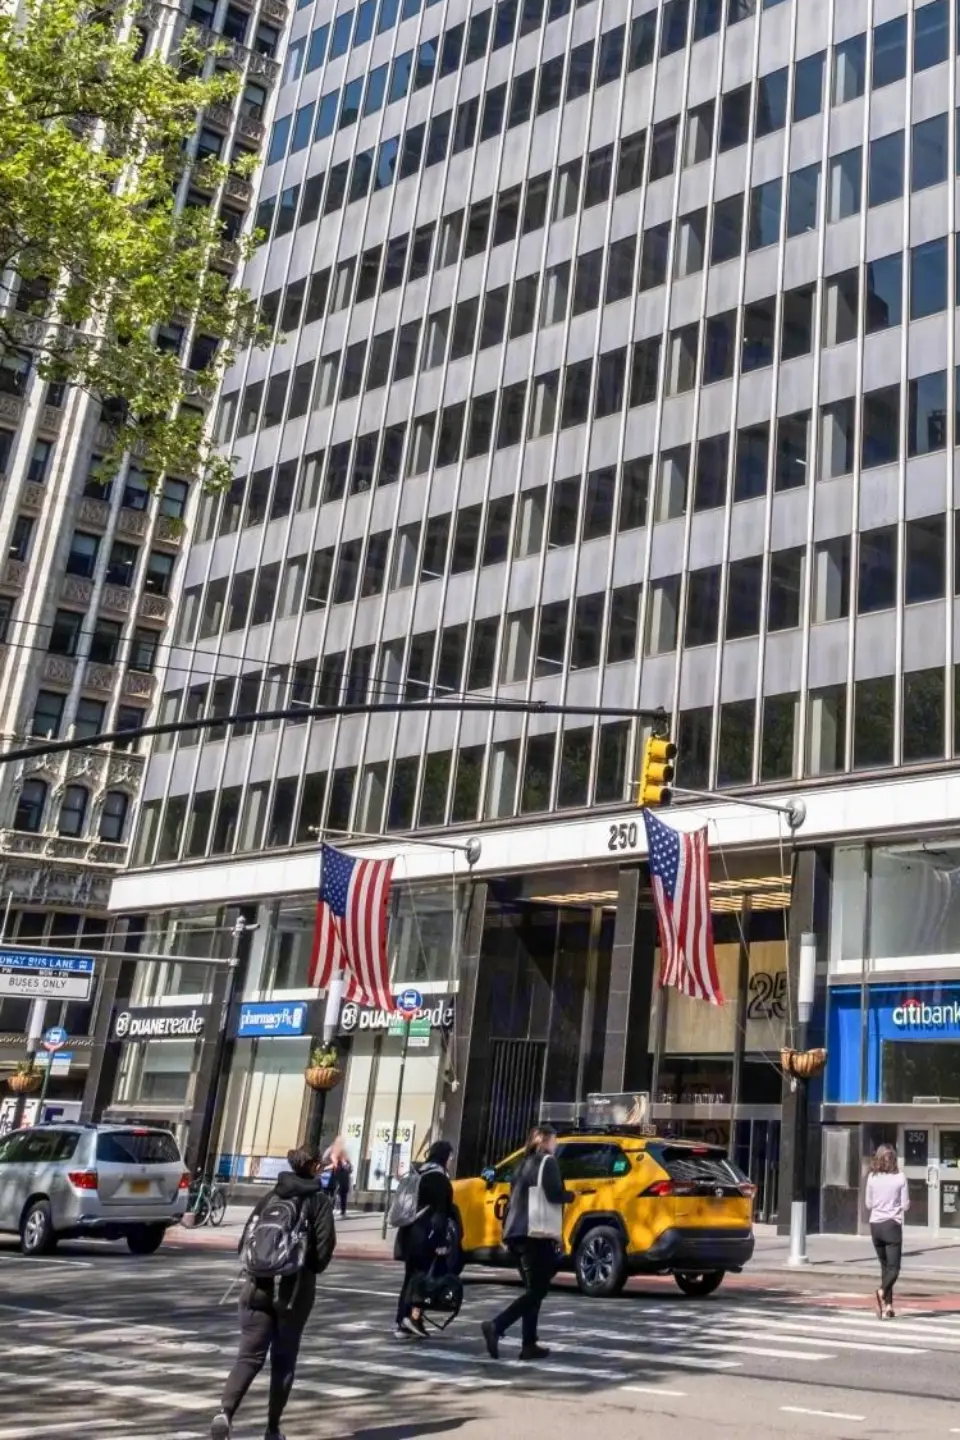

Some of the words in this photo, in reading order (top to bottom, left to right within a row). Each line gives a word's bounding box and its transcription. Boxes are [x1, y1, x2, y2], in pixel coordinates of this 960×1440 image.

[608, 822, 637, 850] 250
[28, 957, 47, 967] BUS
[49, 959, 75, 969] LANE
[9, 977, 40, 988] BUSES
[42, 979, 67, 989] ONLY
[908, 1131, 926, 1143] 250
